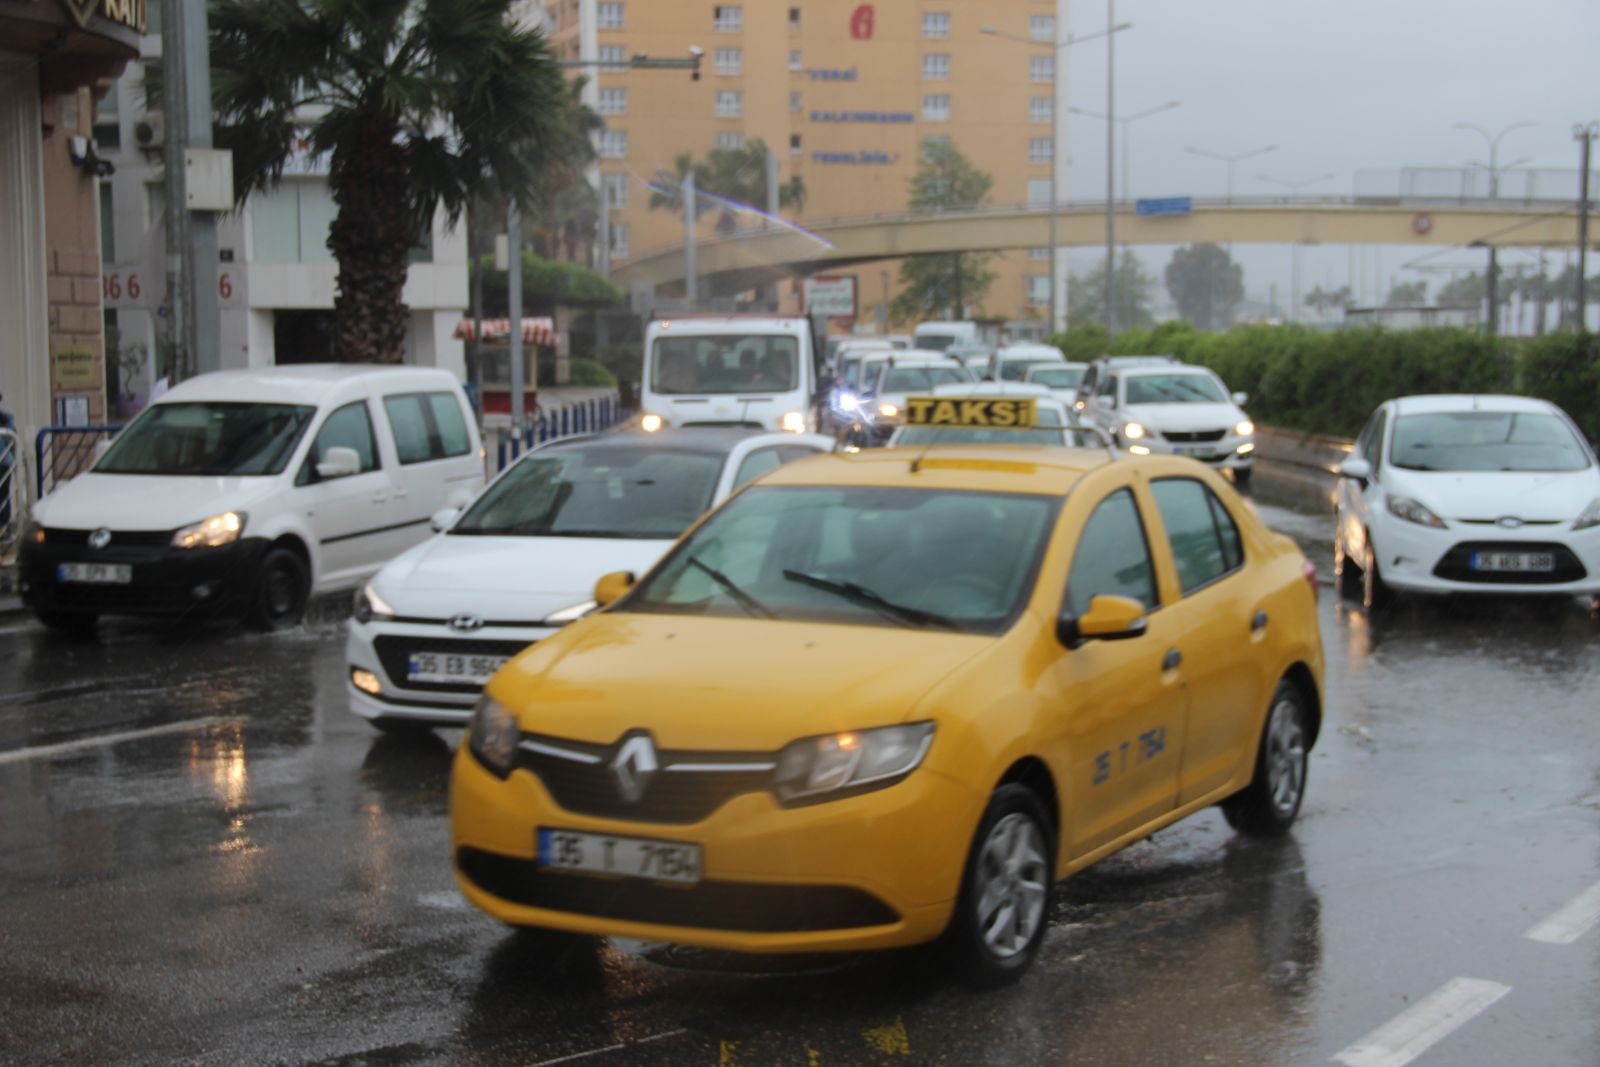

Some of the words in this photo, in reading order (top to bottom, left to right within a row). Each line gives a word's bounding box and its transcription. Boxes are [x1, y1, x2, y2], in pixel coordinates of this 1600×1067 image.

[419, 655, 438, 674] 35
[553, 834, 584, 865] 35
[600, 840, 619, 869] T
[637, 843, 699, 879] 7154
